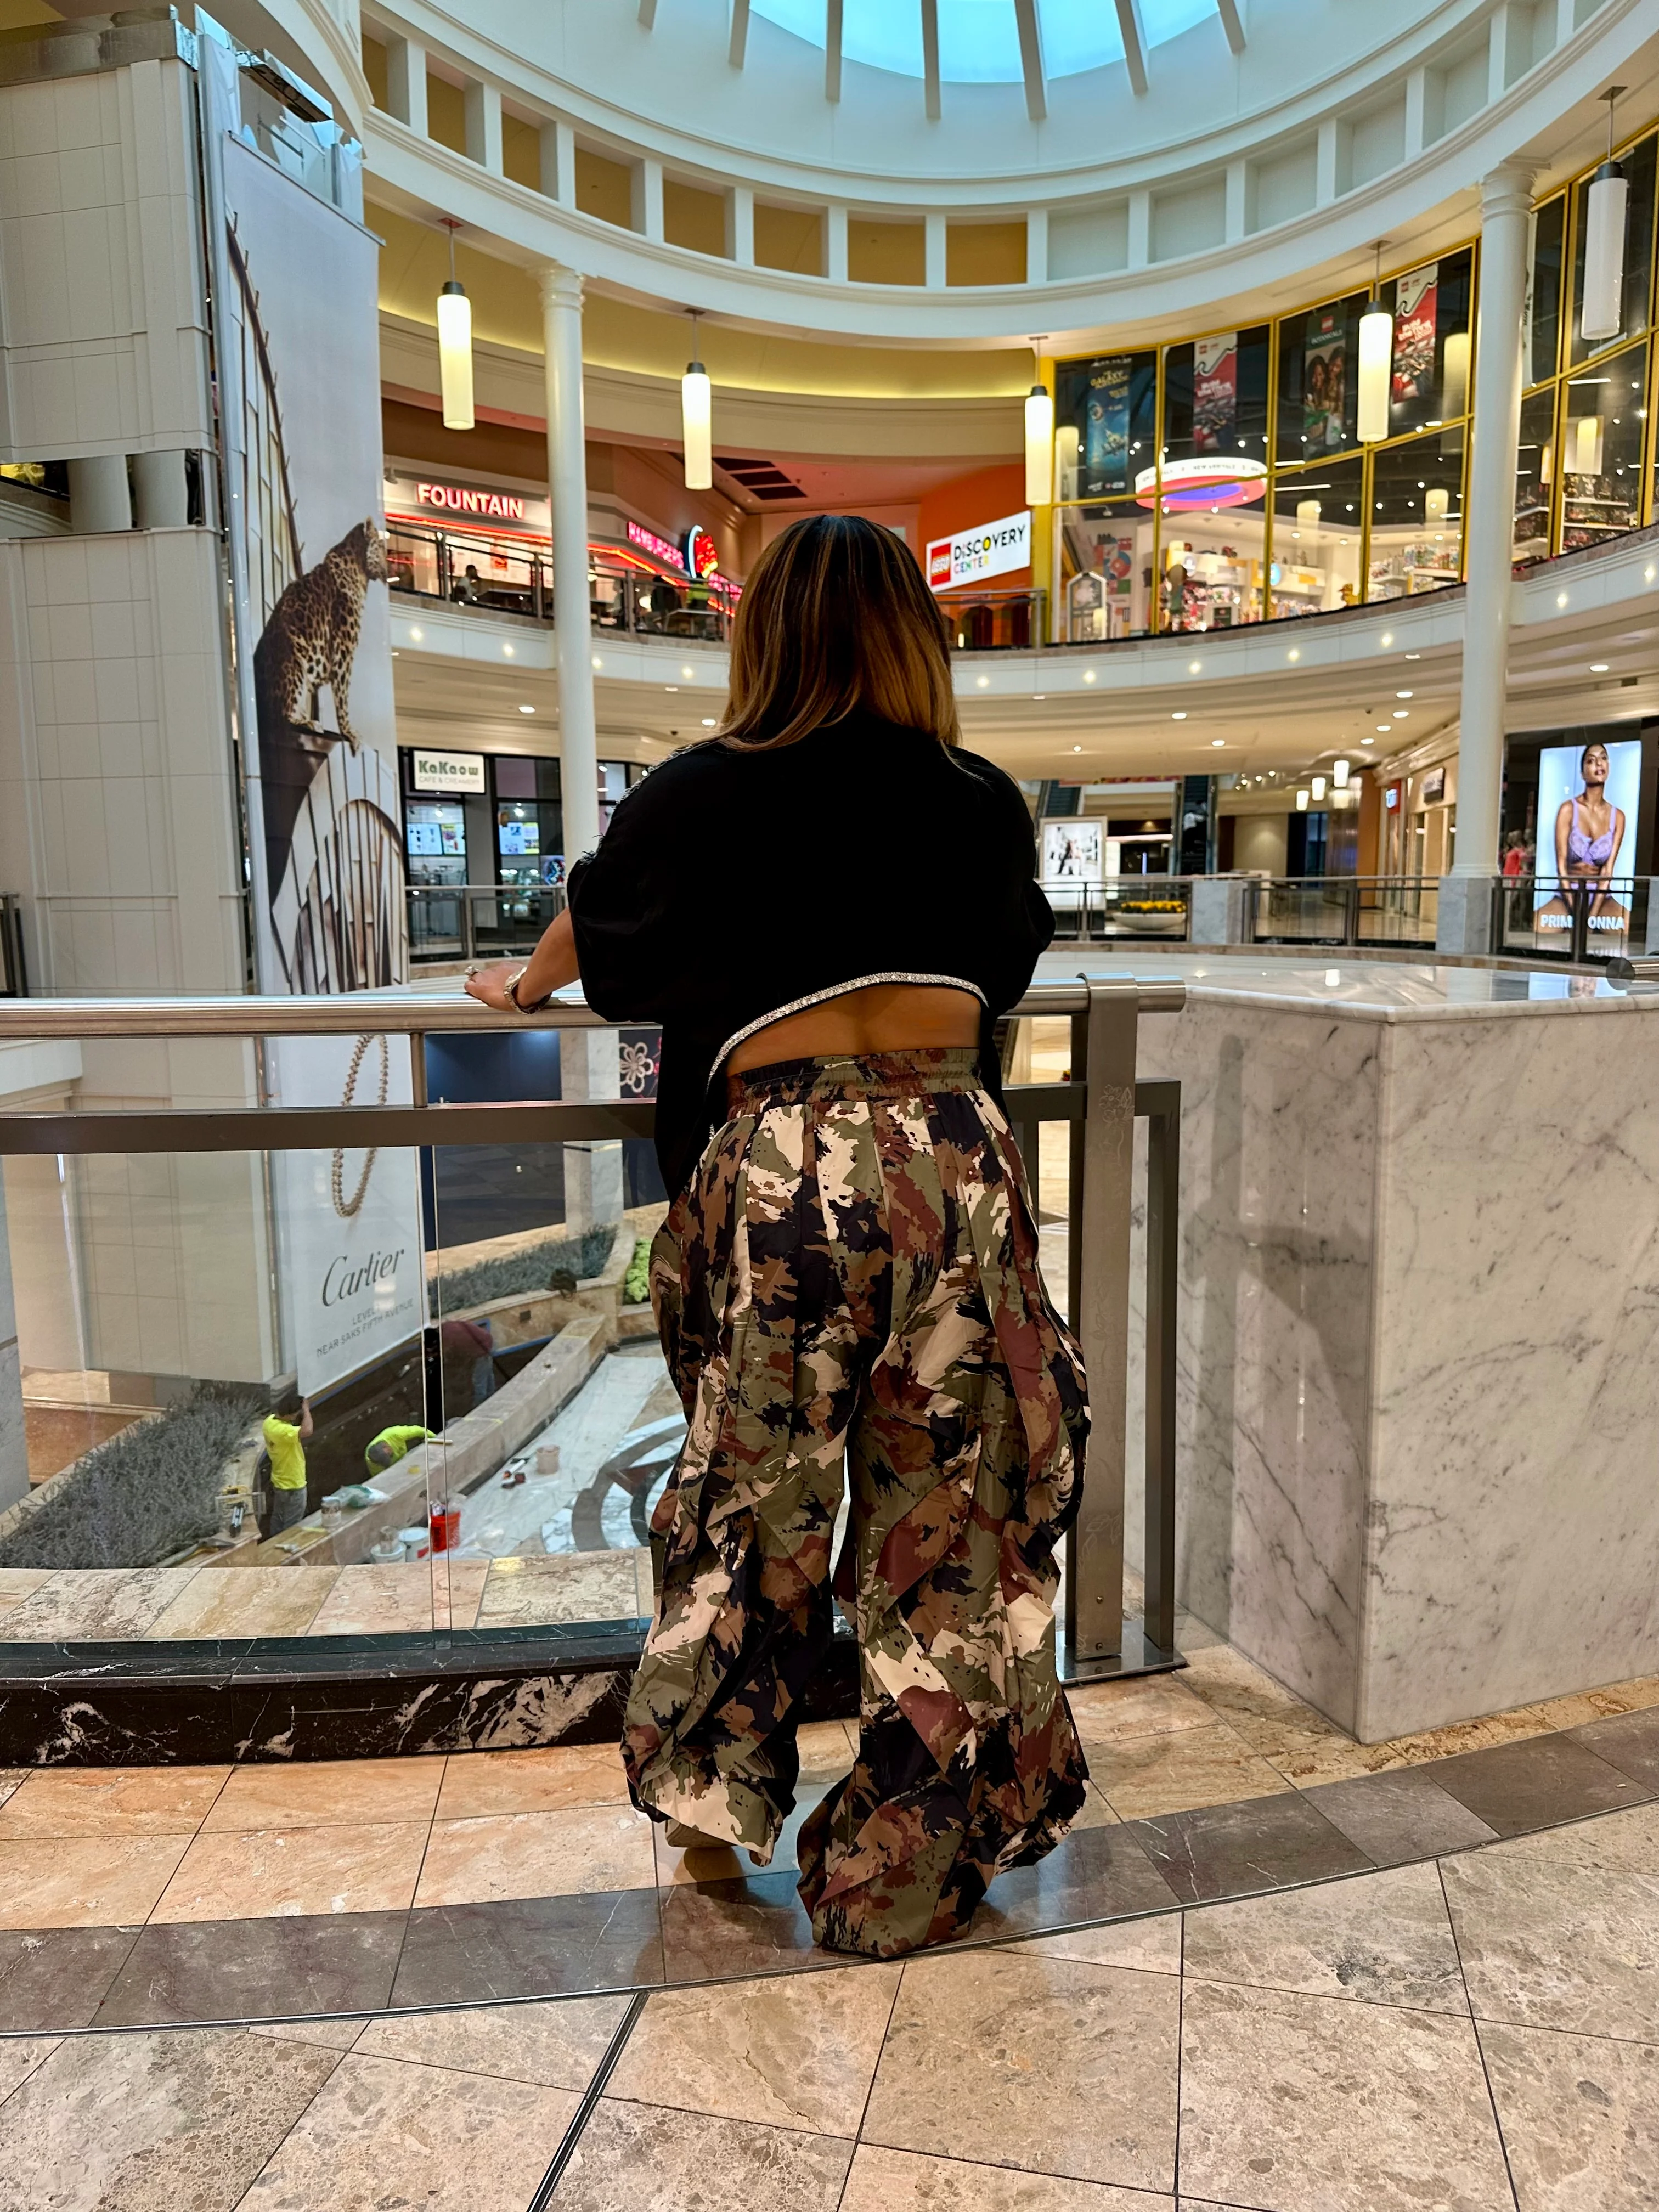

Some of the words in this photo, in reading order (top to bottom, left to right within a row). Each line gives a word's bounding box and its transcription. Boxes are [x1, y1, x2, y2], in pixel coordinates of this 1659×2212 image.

[417, 483, 524, 519] FOUNTAIN
[953, 555, 989, 574] CENTER
[419, 760, 478, 775] KaKaow
[322, 1248, 405, 1307] Cartier
[317, 1339, 339, 1358] NEAR
[341, 1327, 360, 1345] SAKS
[362, 1316, 383, 1333] FIFTH
[385, 1298, 414, 1318] AVENUE
[353, 1307, 376, 1325] LEVEL
